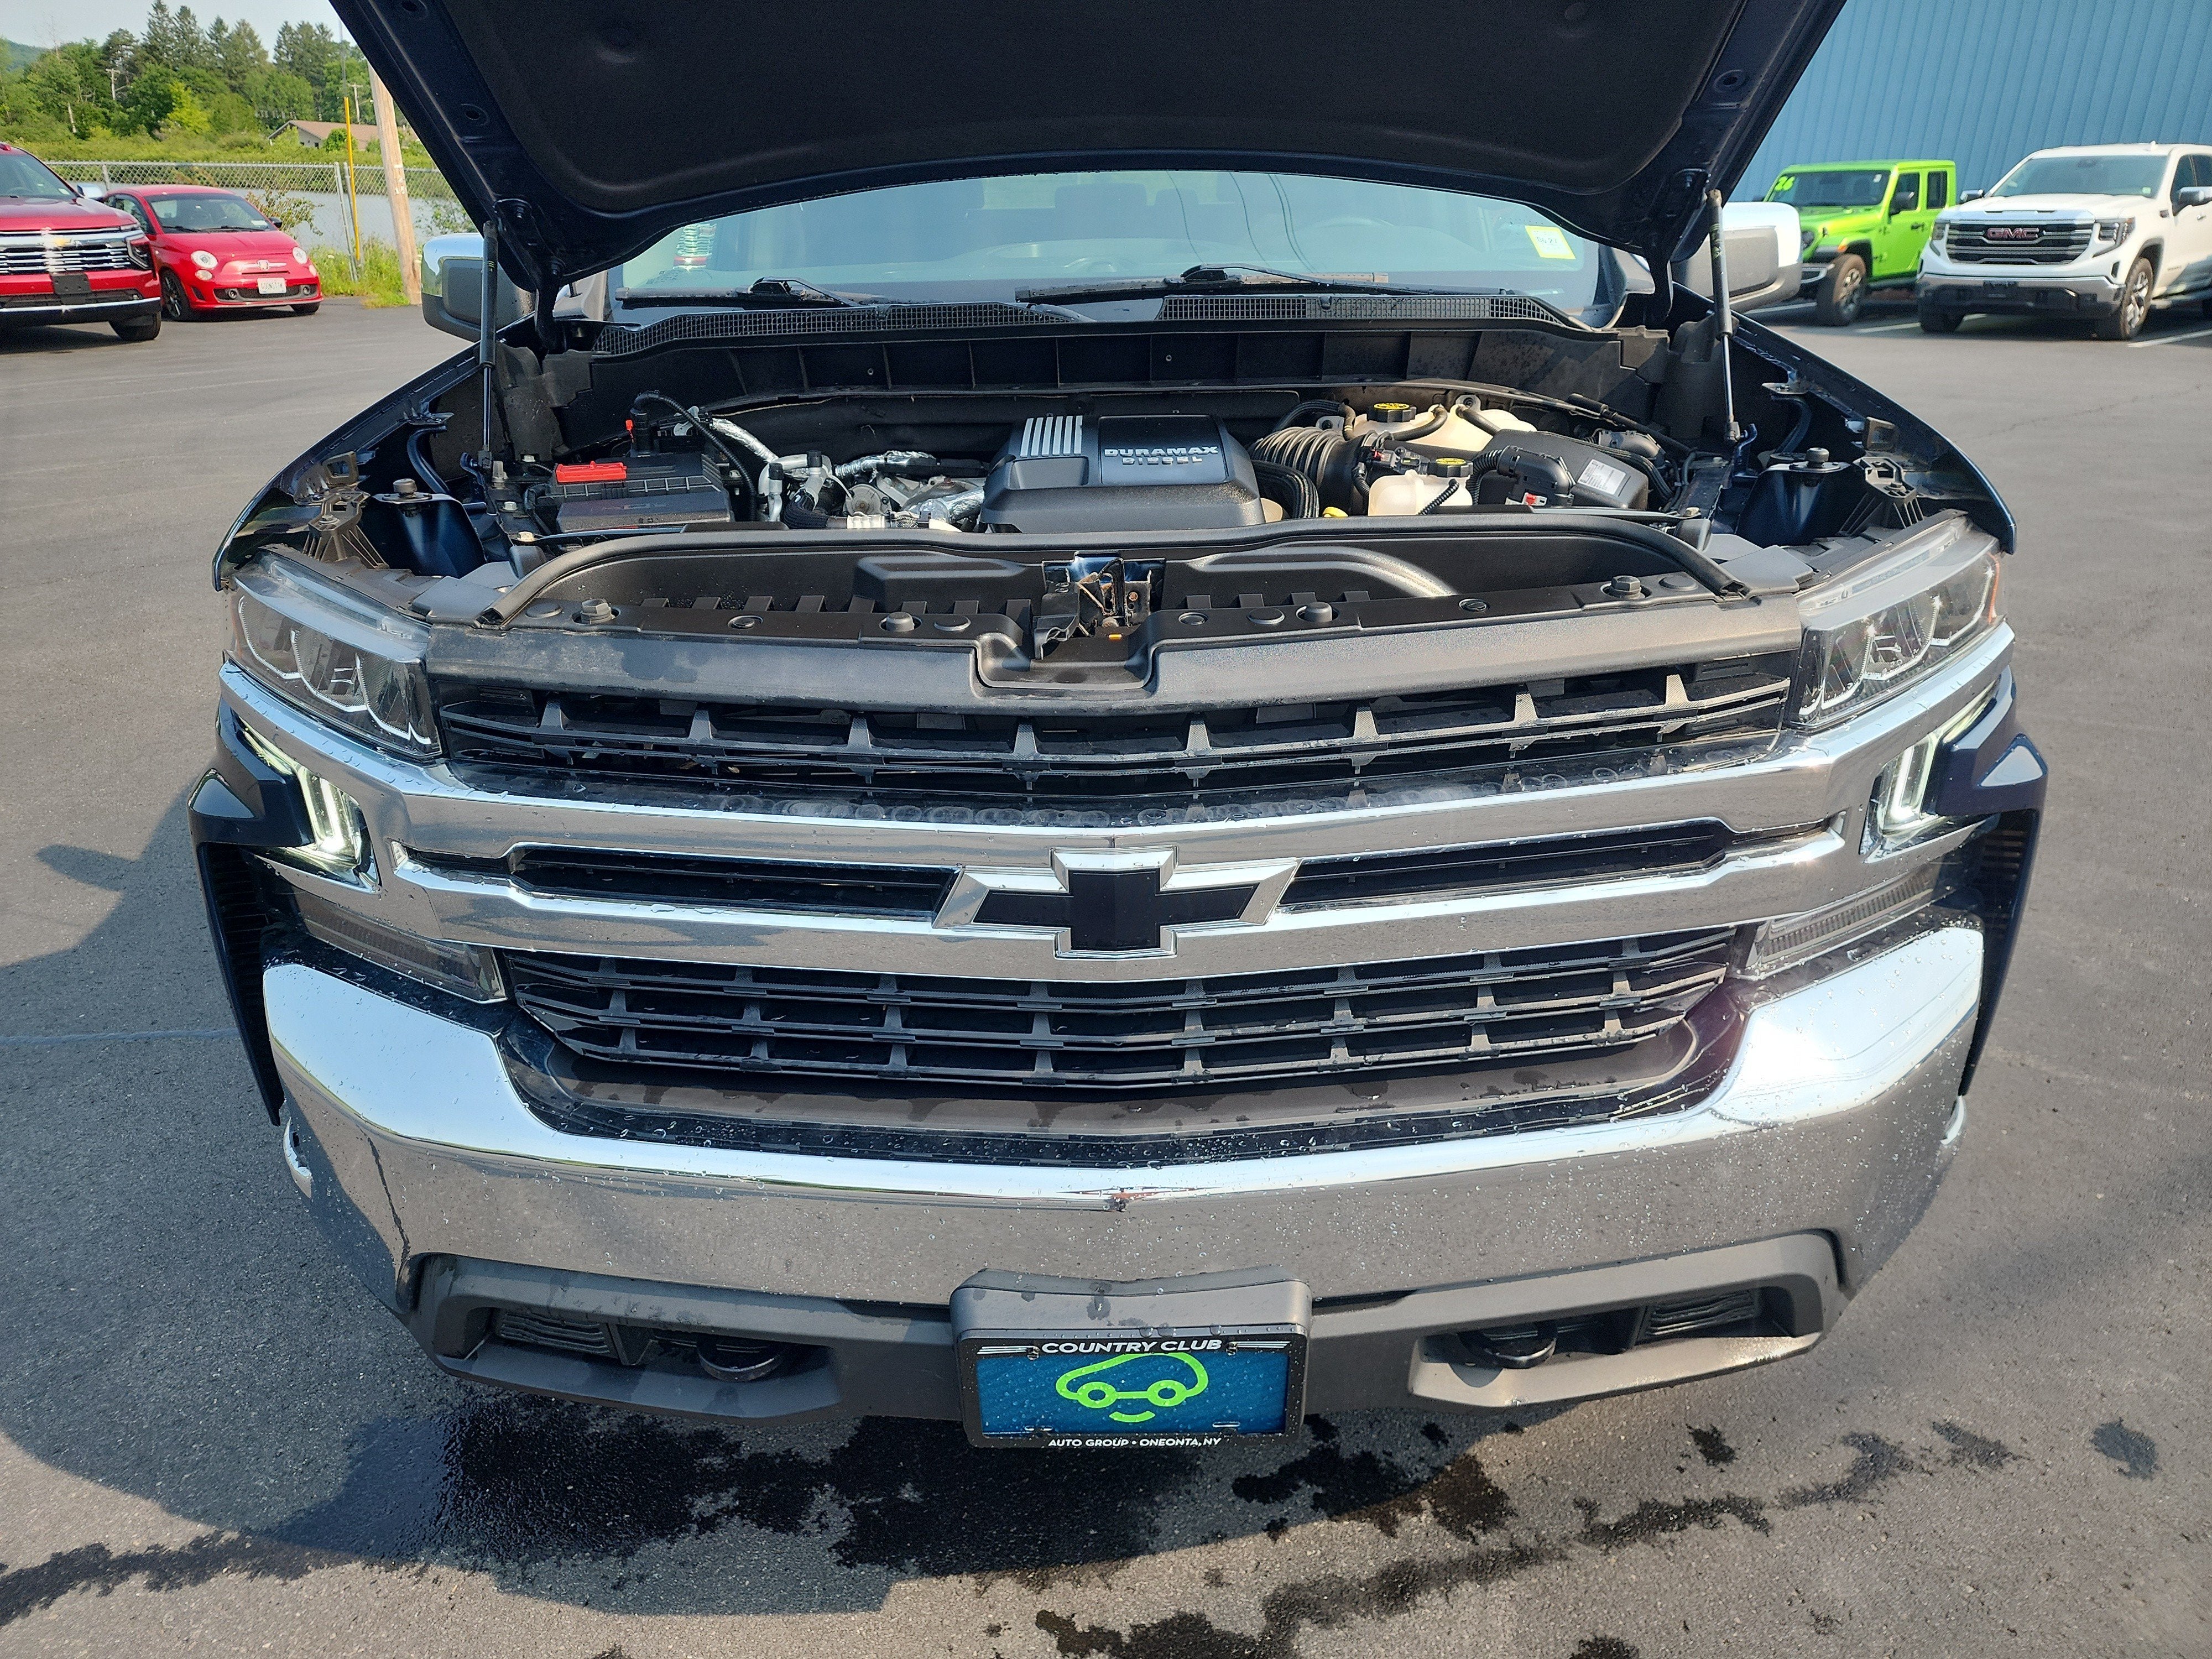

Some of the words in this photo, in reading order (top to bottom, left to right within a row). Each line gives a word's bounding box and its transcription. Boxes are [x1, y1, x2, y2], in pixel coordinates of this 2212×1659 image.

[1775, 176, 1796, 191] 26
[1987, 227, 2039, 240] GMC
[1104, 446, 1219, 457] DURAMAX
[1122, 456, 1203, 465] DIESEL
[1041, 1342, 1157, 1353] COUNTRY
[1160, 1339, 1223, 1351] CLUB
[1085, 1438, 1129, 1447] GROUP
